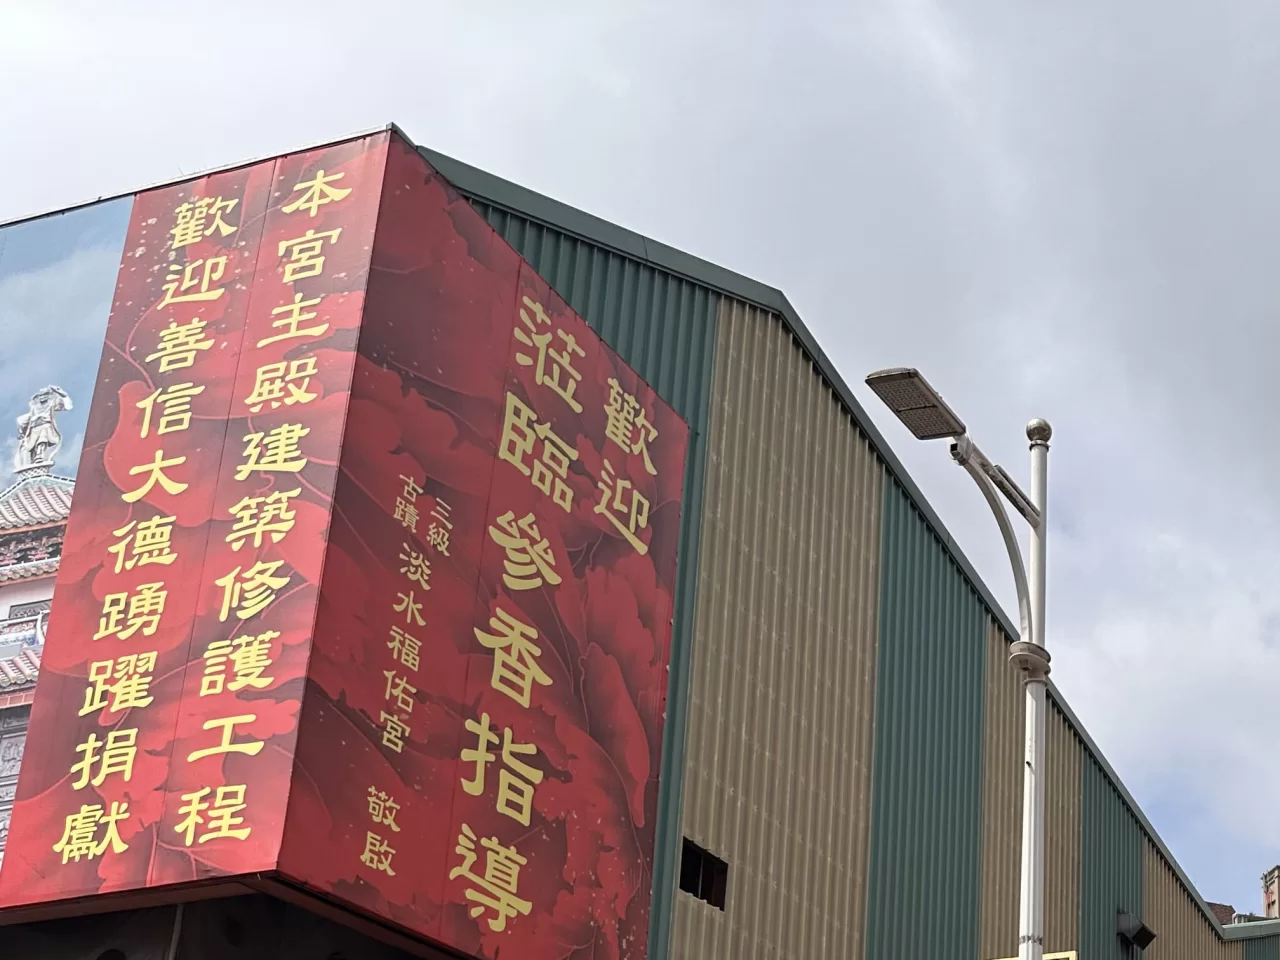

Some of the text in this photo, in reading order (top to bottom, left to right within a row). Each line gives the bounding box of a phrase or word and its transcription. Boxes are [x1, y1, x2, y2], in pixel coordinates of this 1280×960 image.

[52, 195, 240, 867] 歡迎善信大德踴躍捐獻
[173, 169, 353, 848] 本宮主殿建築修護工程
[393, 473, 424, 534] 古蹟
[426, 497, 454, 557] 三級
[594, 377, 659, 556] 歡迎
[379, 542, 432, 754] 淡水福佑宮
[448, 295, 588, 934] 蒞臨參香指導
[360, 786, 401, 877] 敬啟
